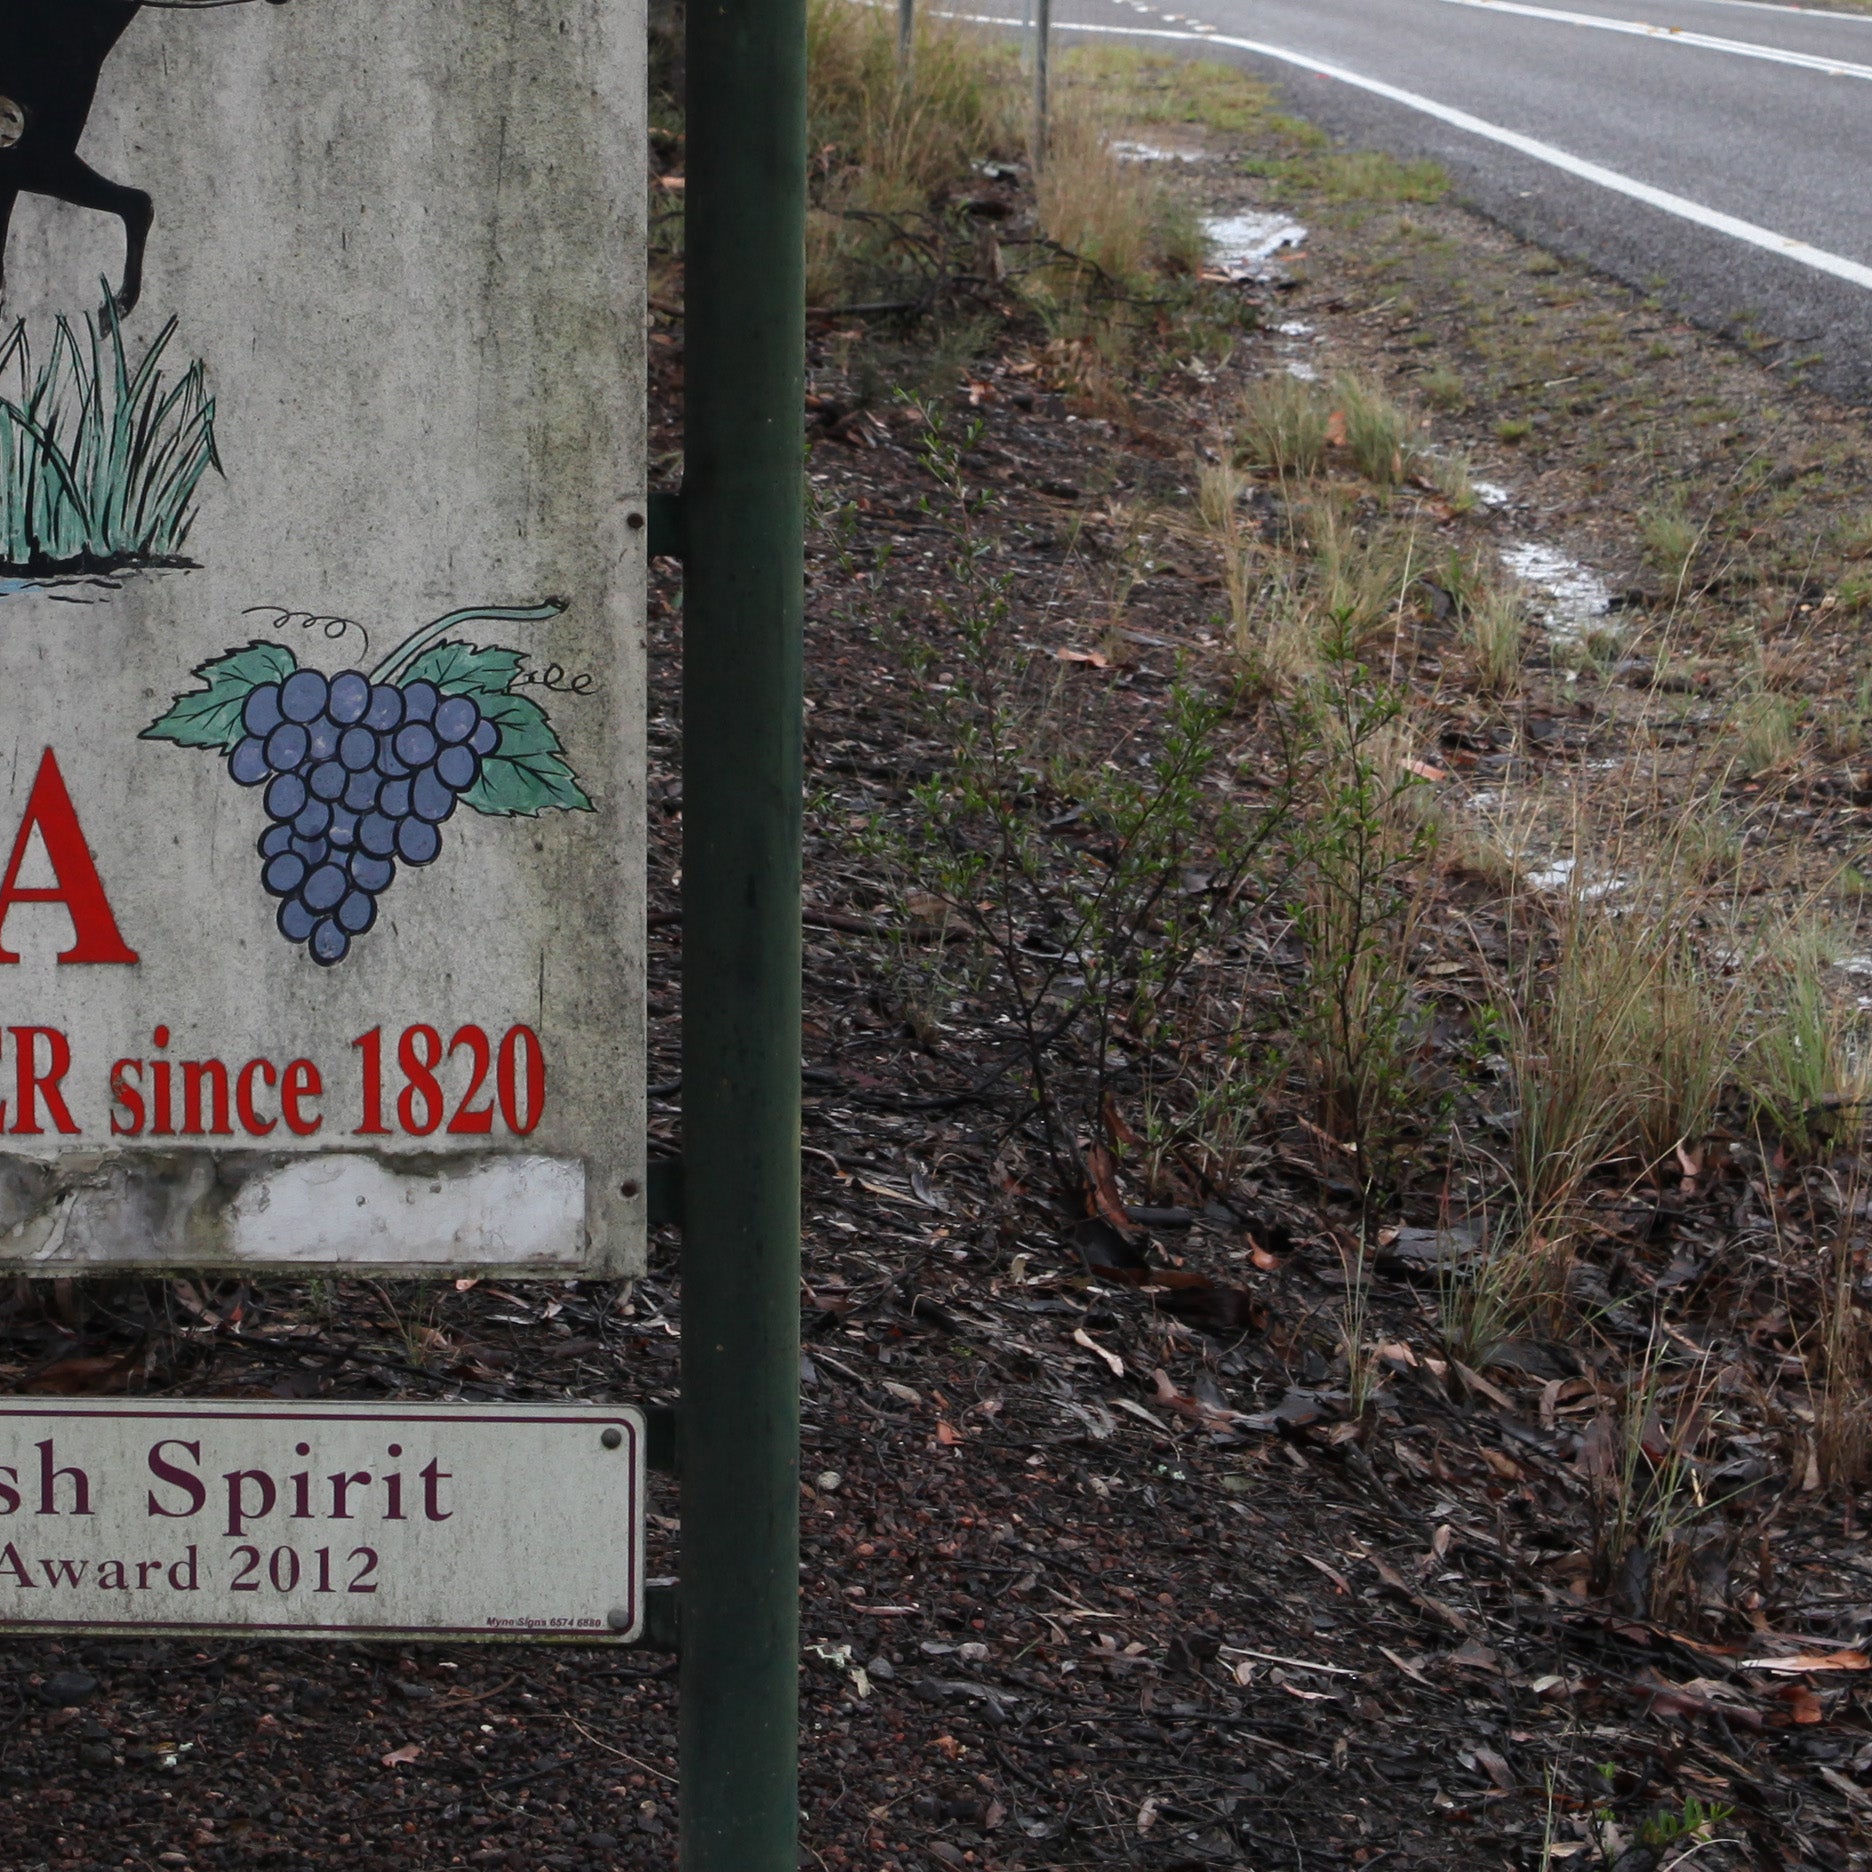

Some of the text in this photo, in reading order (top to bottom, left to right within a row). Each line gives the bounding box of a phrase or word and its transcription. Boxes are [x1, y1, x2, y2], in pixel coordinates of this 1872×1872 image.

[110, 1024, 323, 1137] since
[353, 1023, 546, 1137] 1820
[147, 1439, 454, 1537] Spirit
[230, 1544, 380, 1594] 2012
